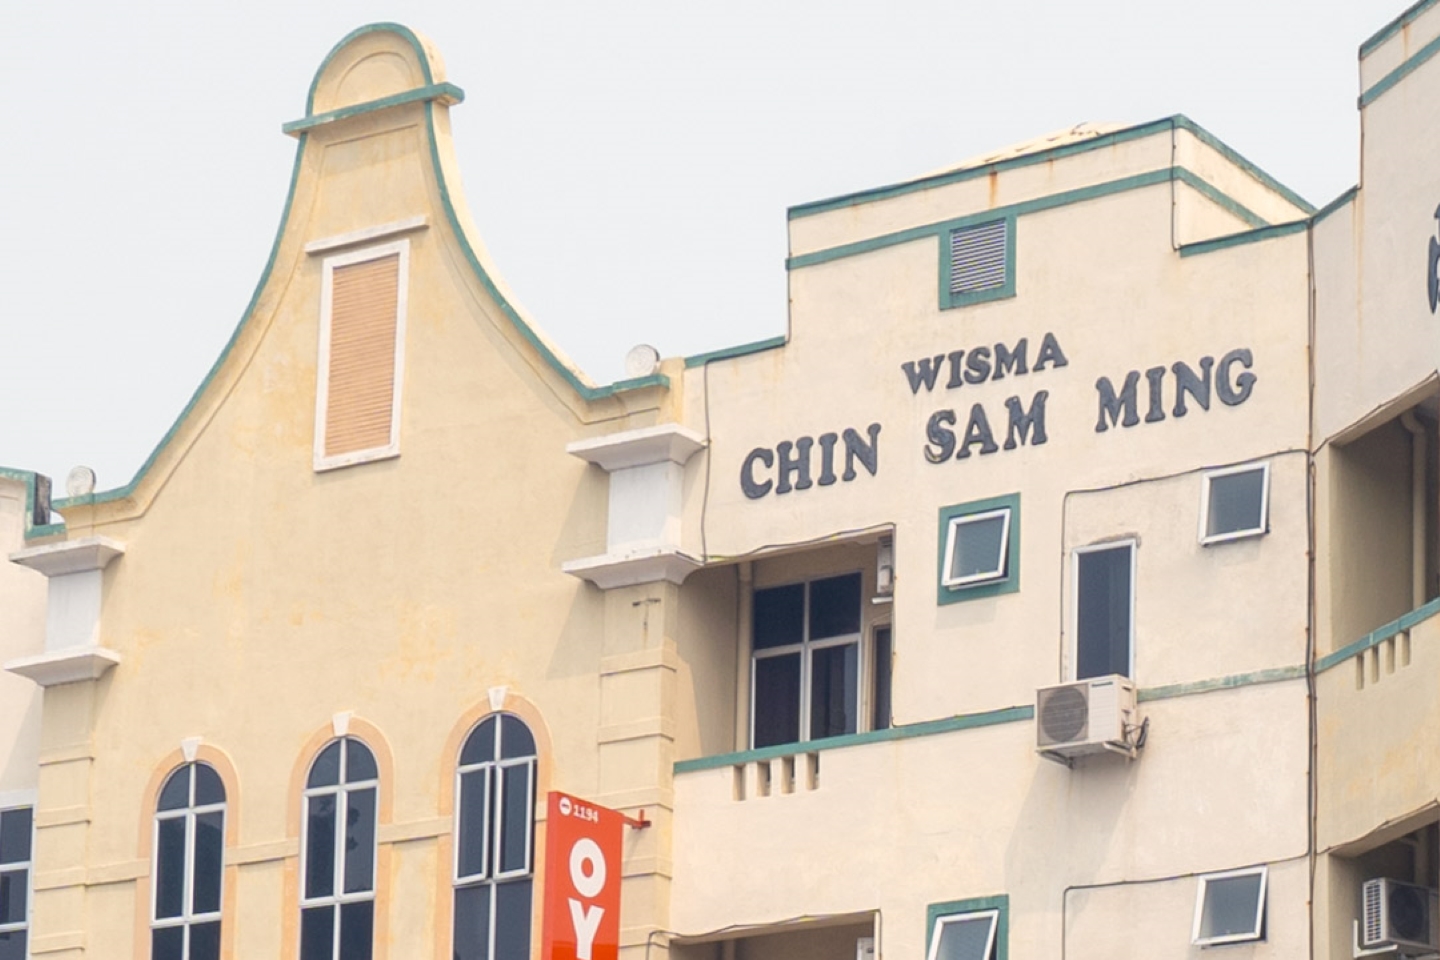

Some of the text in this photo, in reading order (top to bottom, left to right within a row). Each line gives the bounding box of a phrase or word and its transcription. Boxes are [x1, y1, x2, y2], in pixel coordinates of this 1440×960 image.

[901, 332, 1068, 394] WISMA
[740, 348, 1257, 500] CHIN SAM MING
[573, 803, 599, 825] 1194
